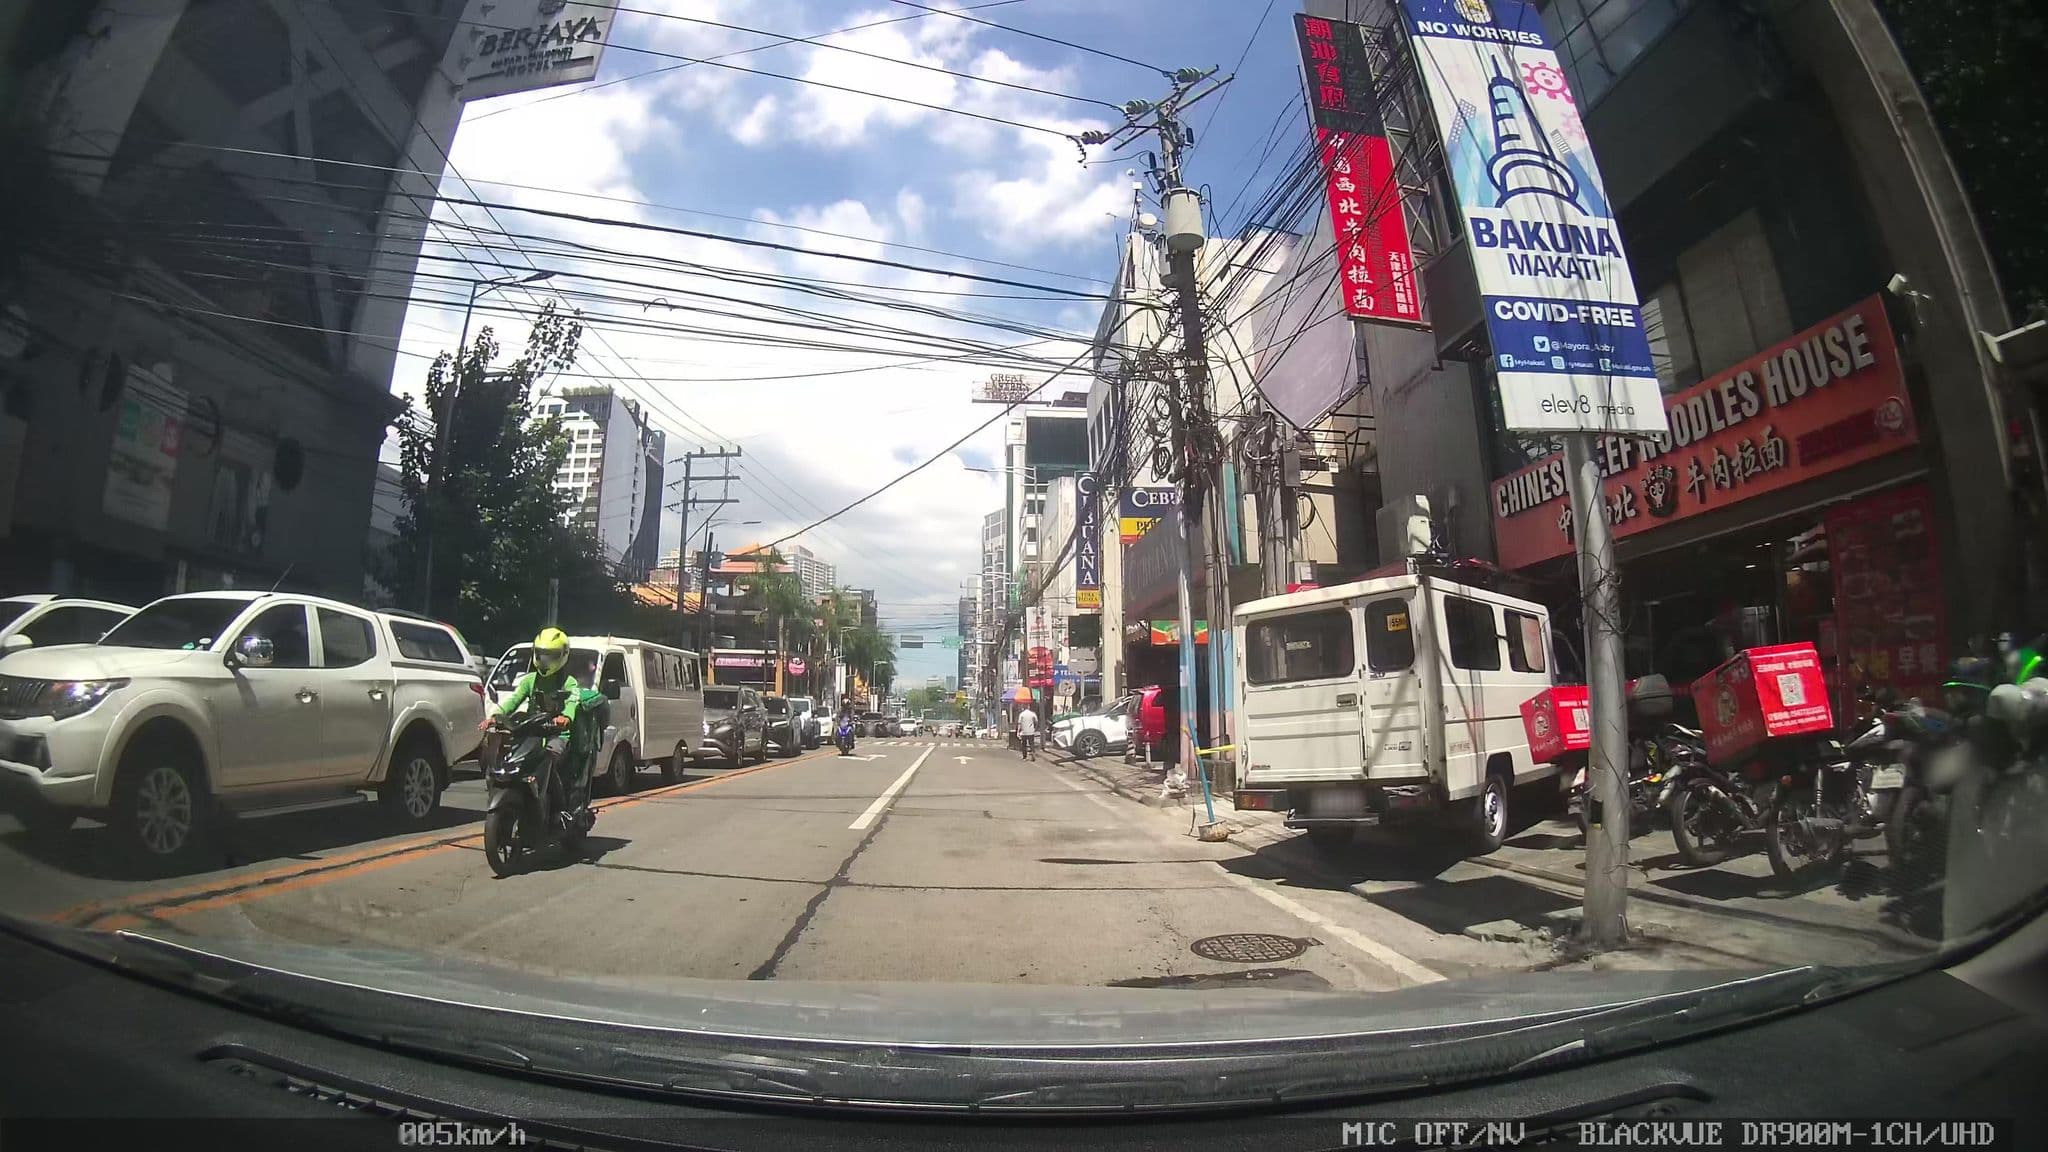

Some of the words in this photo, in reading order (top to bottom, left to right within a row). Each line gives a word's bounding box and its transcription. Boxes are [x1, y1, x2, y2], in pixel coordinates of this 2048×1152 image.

[480, 16, 601, 56] BERJAYA
[1417, 21, 1448, 34] NO
[1451, 23, 1543, 45] WORRIES
[1470, 217, 1621, 258] BAKUNA
[1507, 252, 1602, 281] MAKATI
[1495, 301, 1636, 327] COVID-FREE
[1496, 457, 1572, 519] CHINES
[1761, 314, 1875, 408] HOUSE
[1541, 394, 1591, 414] elev8
[1597, 402, 1636, 415] media
[1686, 426, 1785, 504] 牛肉拉面
